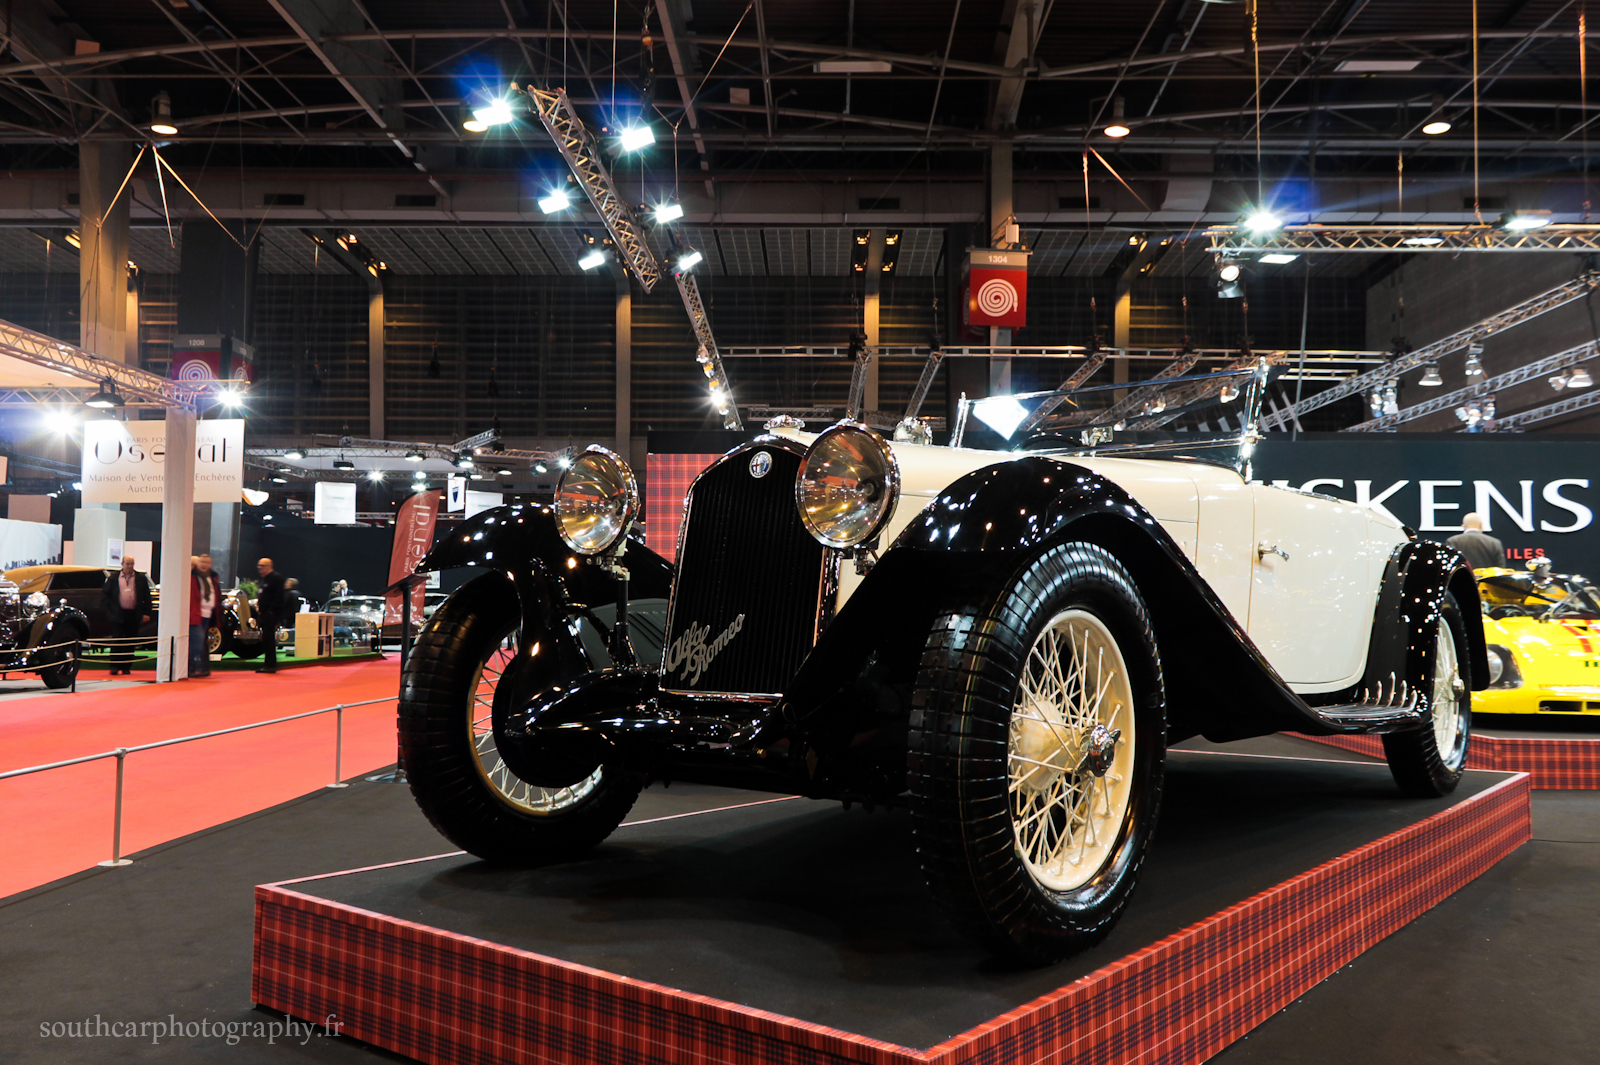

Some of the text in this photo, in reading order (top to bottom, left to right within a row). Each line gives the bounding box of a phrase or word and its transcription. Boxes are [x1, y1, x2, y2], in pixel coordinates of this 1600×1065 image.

[988, 255, 1008, 263] 1304
[95, 436, 233, 464] Oseat
[89, 472, 237, 482] Maison de Vente Enchères
[127, 484, 164, 493] Auction
[667, 620, 711, 681] Alfa
[688, 613, 746, 687] Romeo
